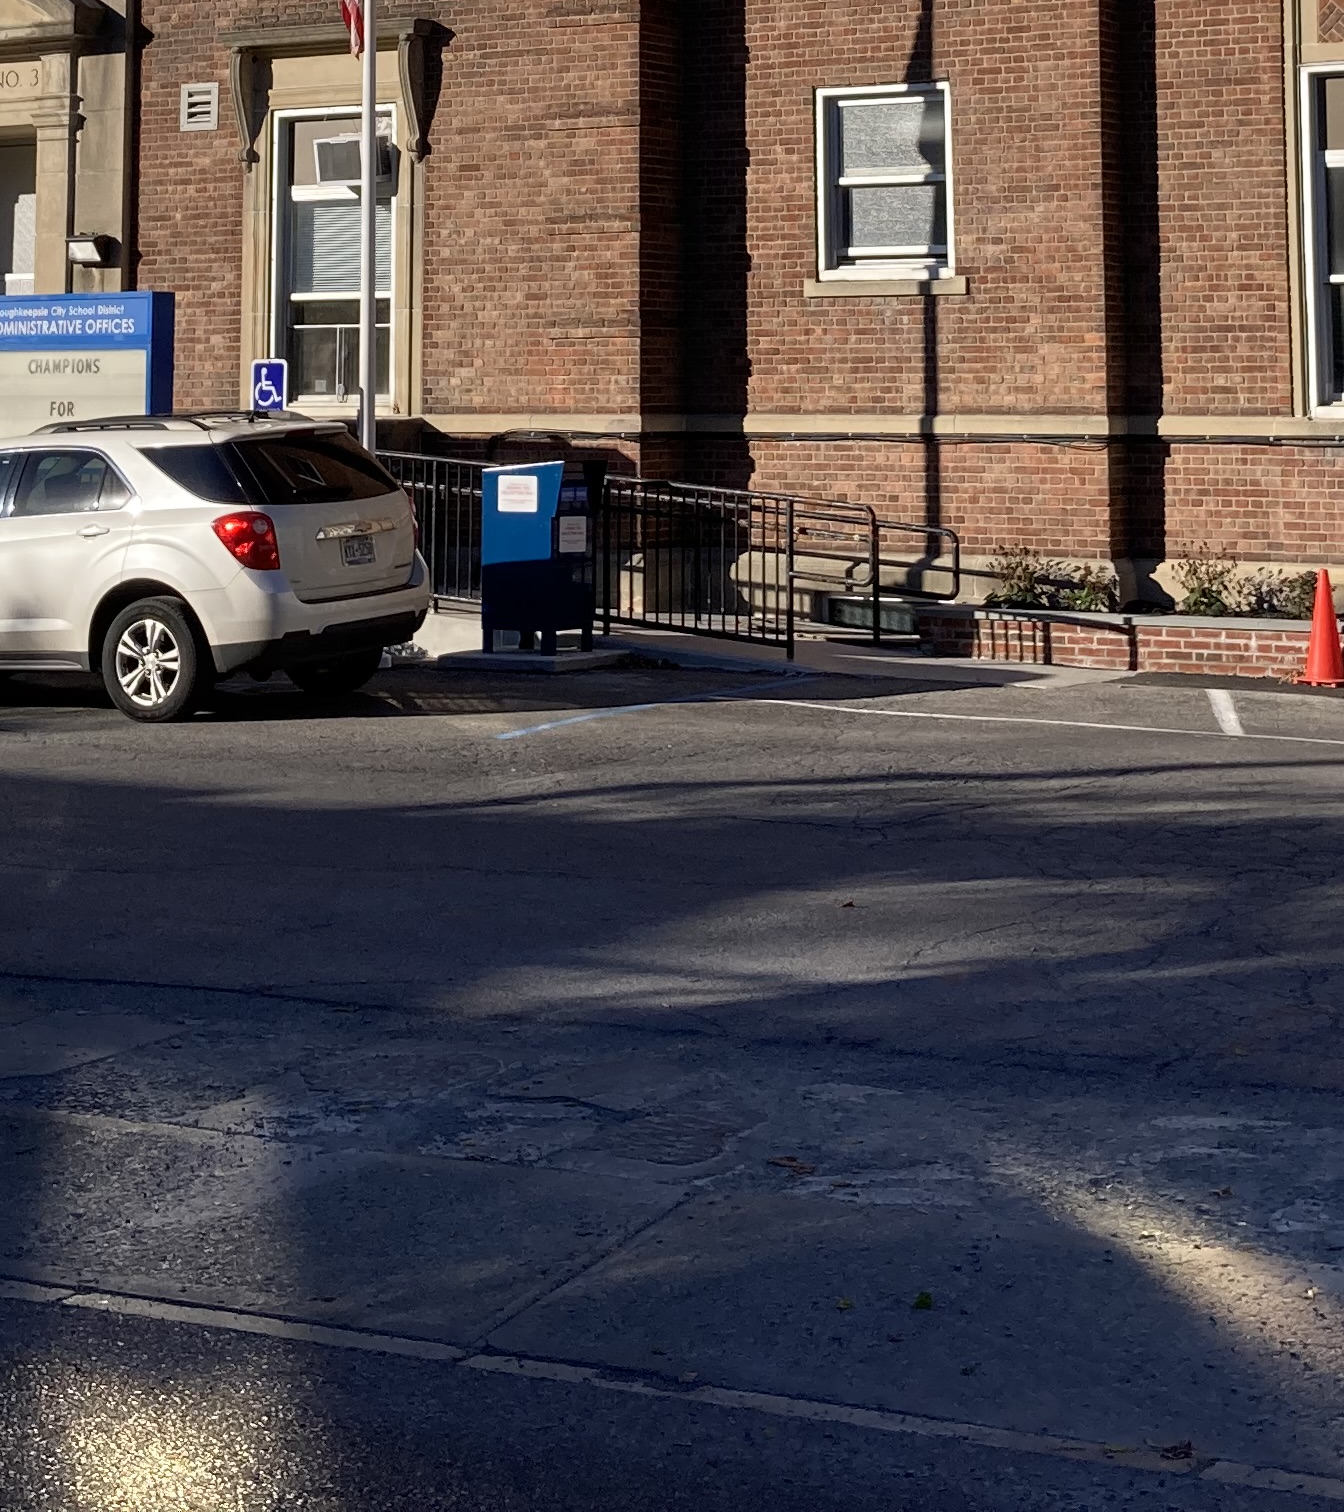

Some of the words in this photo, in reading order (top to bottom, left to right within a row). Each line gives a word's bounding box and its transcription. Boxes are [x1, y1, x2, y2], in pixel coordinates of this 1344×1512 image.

[30, 68, 39, 87] 3
[51, 306, 67, 318] City
[68, 305, 95, 316] School
[97, 304, 125, 315] District
[85, 318, 135, 335] OFFICES
[28, 358, 101, 375] CHAMPIONS
[49, 401, 75, 417] FOR
